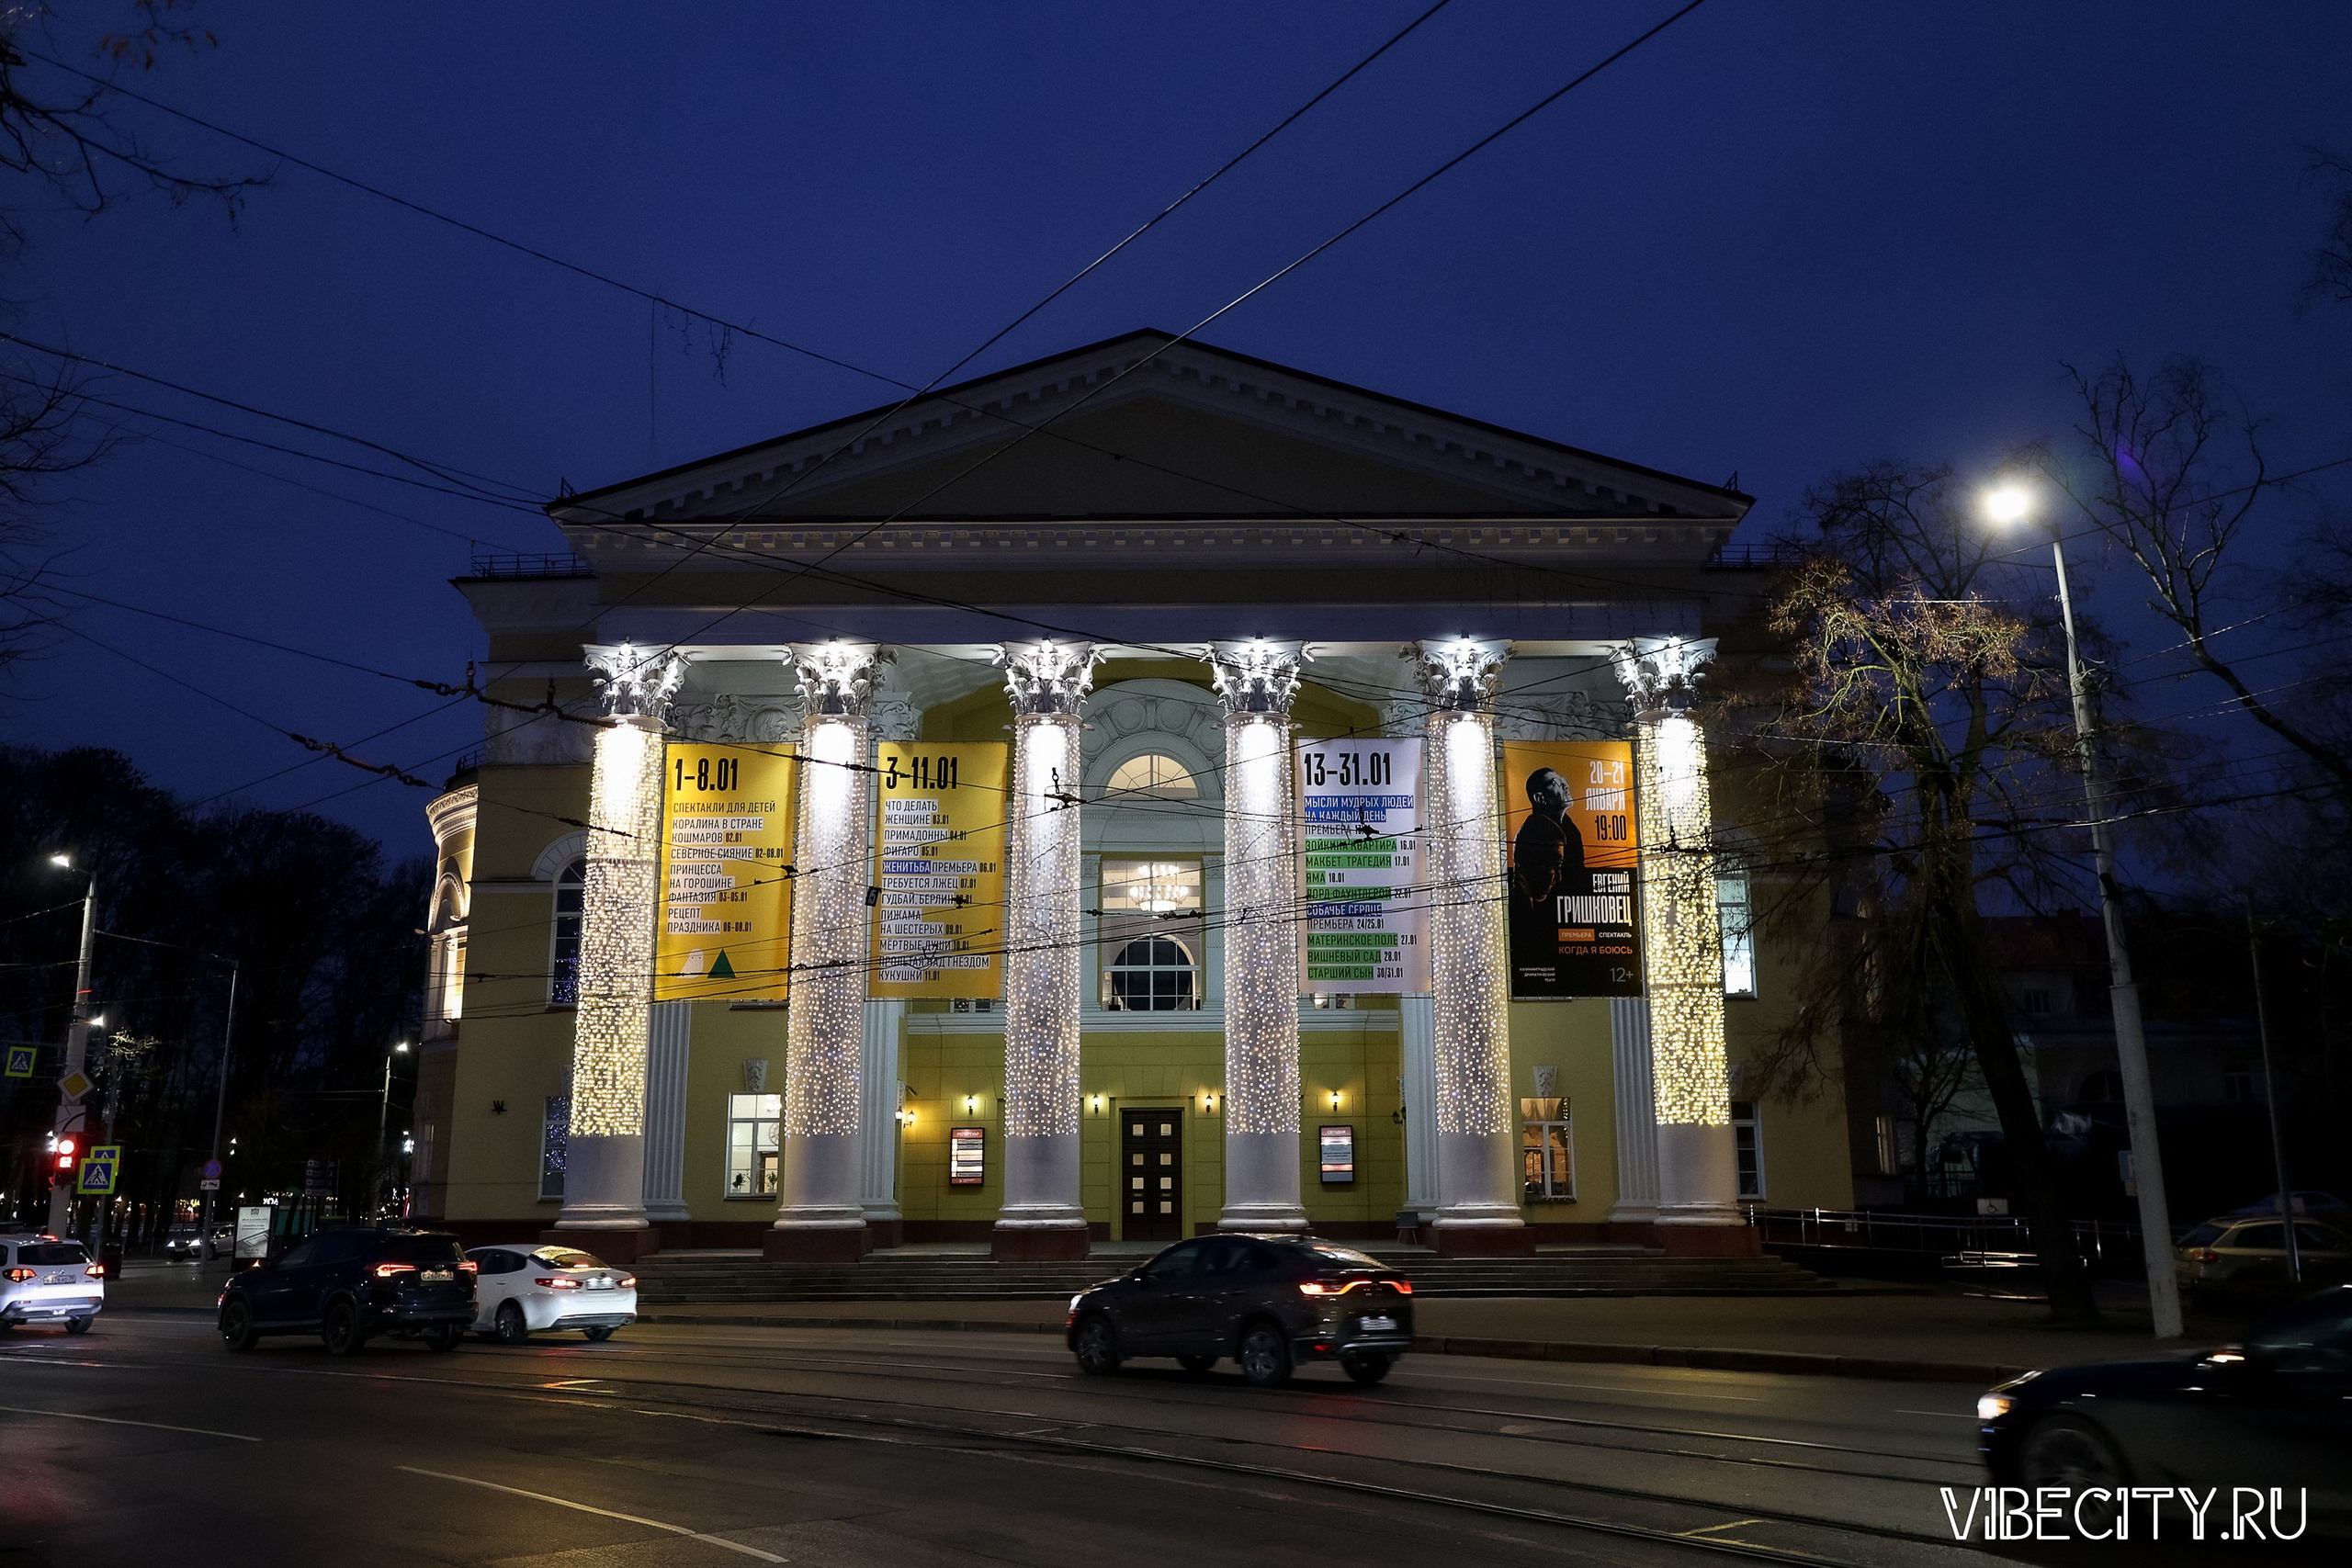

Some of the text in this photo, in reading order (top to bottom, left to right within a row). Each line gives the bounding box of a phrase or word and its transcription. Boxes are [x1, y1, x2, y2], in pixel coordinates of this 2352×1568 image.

[886, 756, 957, 789] 3-11.01
[1305, 752, 1391, 785] 13-31.01
[1589, 761, 1624, 784] 20-21
[675, 758, 738, 791] 1-8.01
[1306, 795, 1414, 808] МЫСЛИ МУДРЫХ ЛЮДЕЙ
[1586, 788, 1625, 810] ЯНВАРЯ
[673, 800, 775, 814] СПЕКТАКЛИ ДЛЯ ДЕТЕЙ
[885, 801, 937, 811] ЧТО ДЕЛАТЬ
[885, 815, 949, 825] ЖЕНЩИНЕ 03.01
[1306, 809, 1386, 822] НА КАЖДЫЙ ДЕНЬ
[673, 818, 763, 829] КОРАЛИНА В СТРАНЕ
[1306, 825, 1351, 834] ПРЕМЬЕРА
[672, 832, 742, 843] КОШМАРОВ 02.01
[884, 830, 967, 841] ПРИМАДОННЫ 04.01
[1351, 840, 1396, 850] КВАРТИРА
[1400, 840, 1416, 850] 16.01
[671, 848, 784, 859] СЕВЕРНОЕ СИЯНИЕ 02-08.01
[884, 846, 938, 856] ФИГАРО 05.01
[882, 862, 996, 873] ЖЕНИТЬБА ПРЕМЬЕРА 06.01
[1306, 856, 1409, 868] МАКБЕТ. ТРАГЕДИЯ 17.01
[670, 864, 722, 875] ПРИНЦЕССА
[670, 878, 735, 888] НА ГОРОШИНЕ.
[882, 878, 977, 889] ТРЕБУЕТСЯ ЛЖЕЦ 07.01
[1306, 873, 1344, 883] ЯМА 18.01
[1592, 871, 1630, 893] ЕВГЕНИЙ
[669, 892, 748, 902] ФАНТАЗИЯ 03-05.01
[919, 895, 953, 905] БЕРЛИН
[668, 908, 701, 919] РЕЦЕПТ
[881, 909, 921, 919] ПИЖАМА
[1306, 905, 1345, 916] СОБАЧЬЕ
[1556, 896, 1633, 927] ГРИШКОВЕЦ
[668, 921, 752, 933] ПРАЗДНИКА 06-08.01
[880, 924, 962, 934] НА ШЕСТЕРЫХ 09.01
[1306, 919, 1385, 930] ПРЕМЬЕРА 24/25.01
[880, 938, 922, 950] МЁРТВЫЕ
[925, 941, 951, 951] ДУШИ
[1307, 935, 1417, 945] МАТЕРИНСКОЕ ПОЛЕ 27.01
[1558, 946, 1633, 955] КОГДА Я БОЮСЬ
[947, 957, 989, 967] ГНЕЗДОМ
[1307, 950, 1401, 963] ВИШНЁВЫЙ САД 28.01
[878, 971, 940, 981] КУКУШКИ 11.01
[1308, 966, 1403, 978] СТАРШИЙ СЫН 30/31.01
[1610, 967, 1634, 982] 12+
